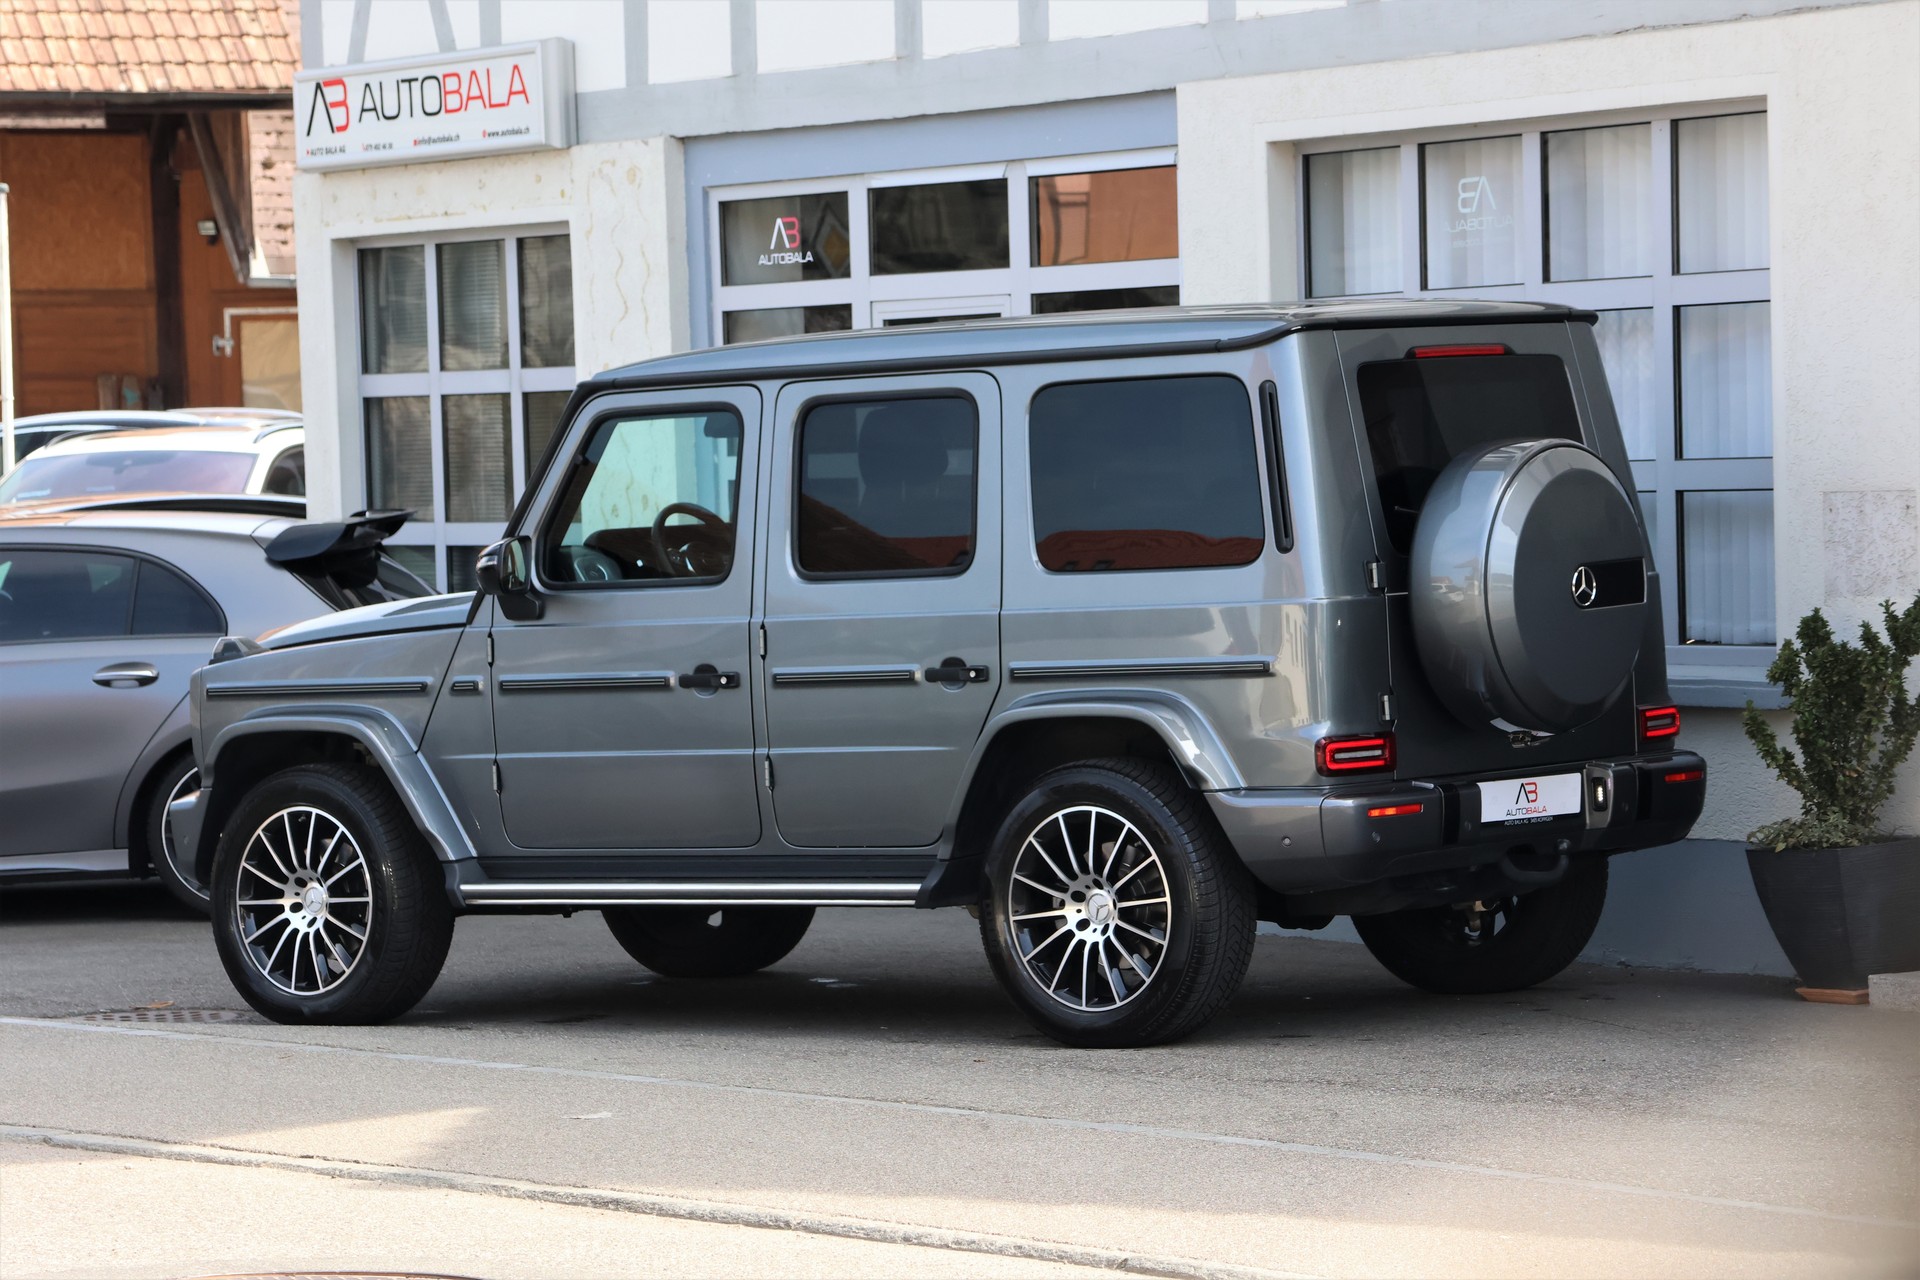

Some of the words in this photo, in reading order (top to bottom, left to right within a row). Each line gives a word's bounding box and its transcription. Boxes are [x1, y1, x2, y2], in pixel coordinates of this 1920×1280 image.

[358, 63, 530, 124] AUTOBALA
[758, 250, 814, 266] AUTOBALA
[1505, 805, 1547, 817] AUTOBALA
